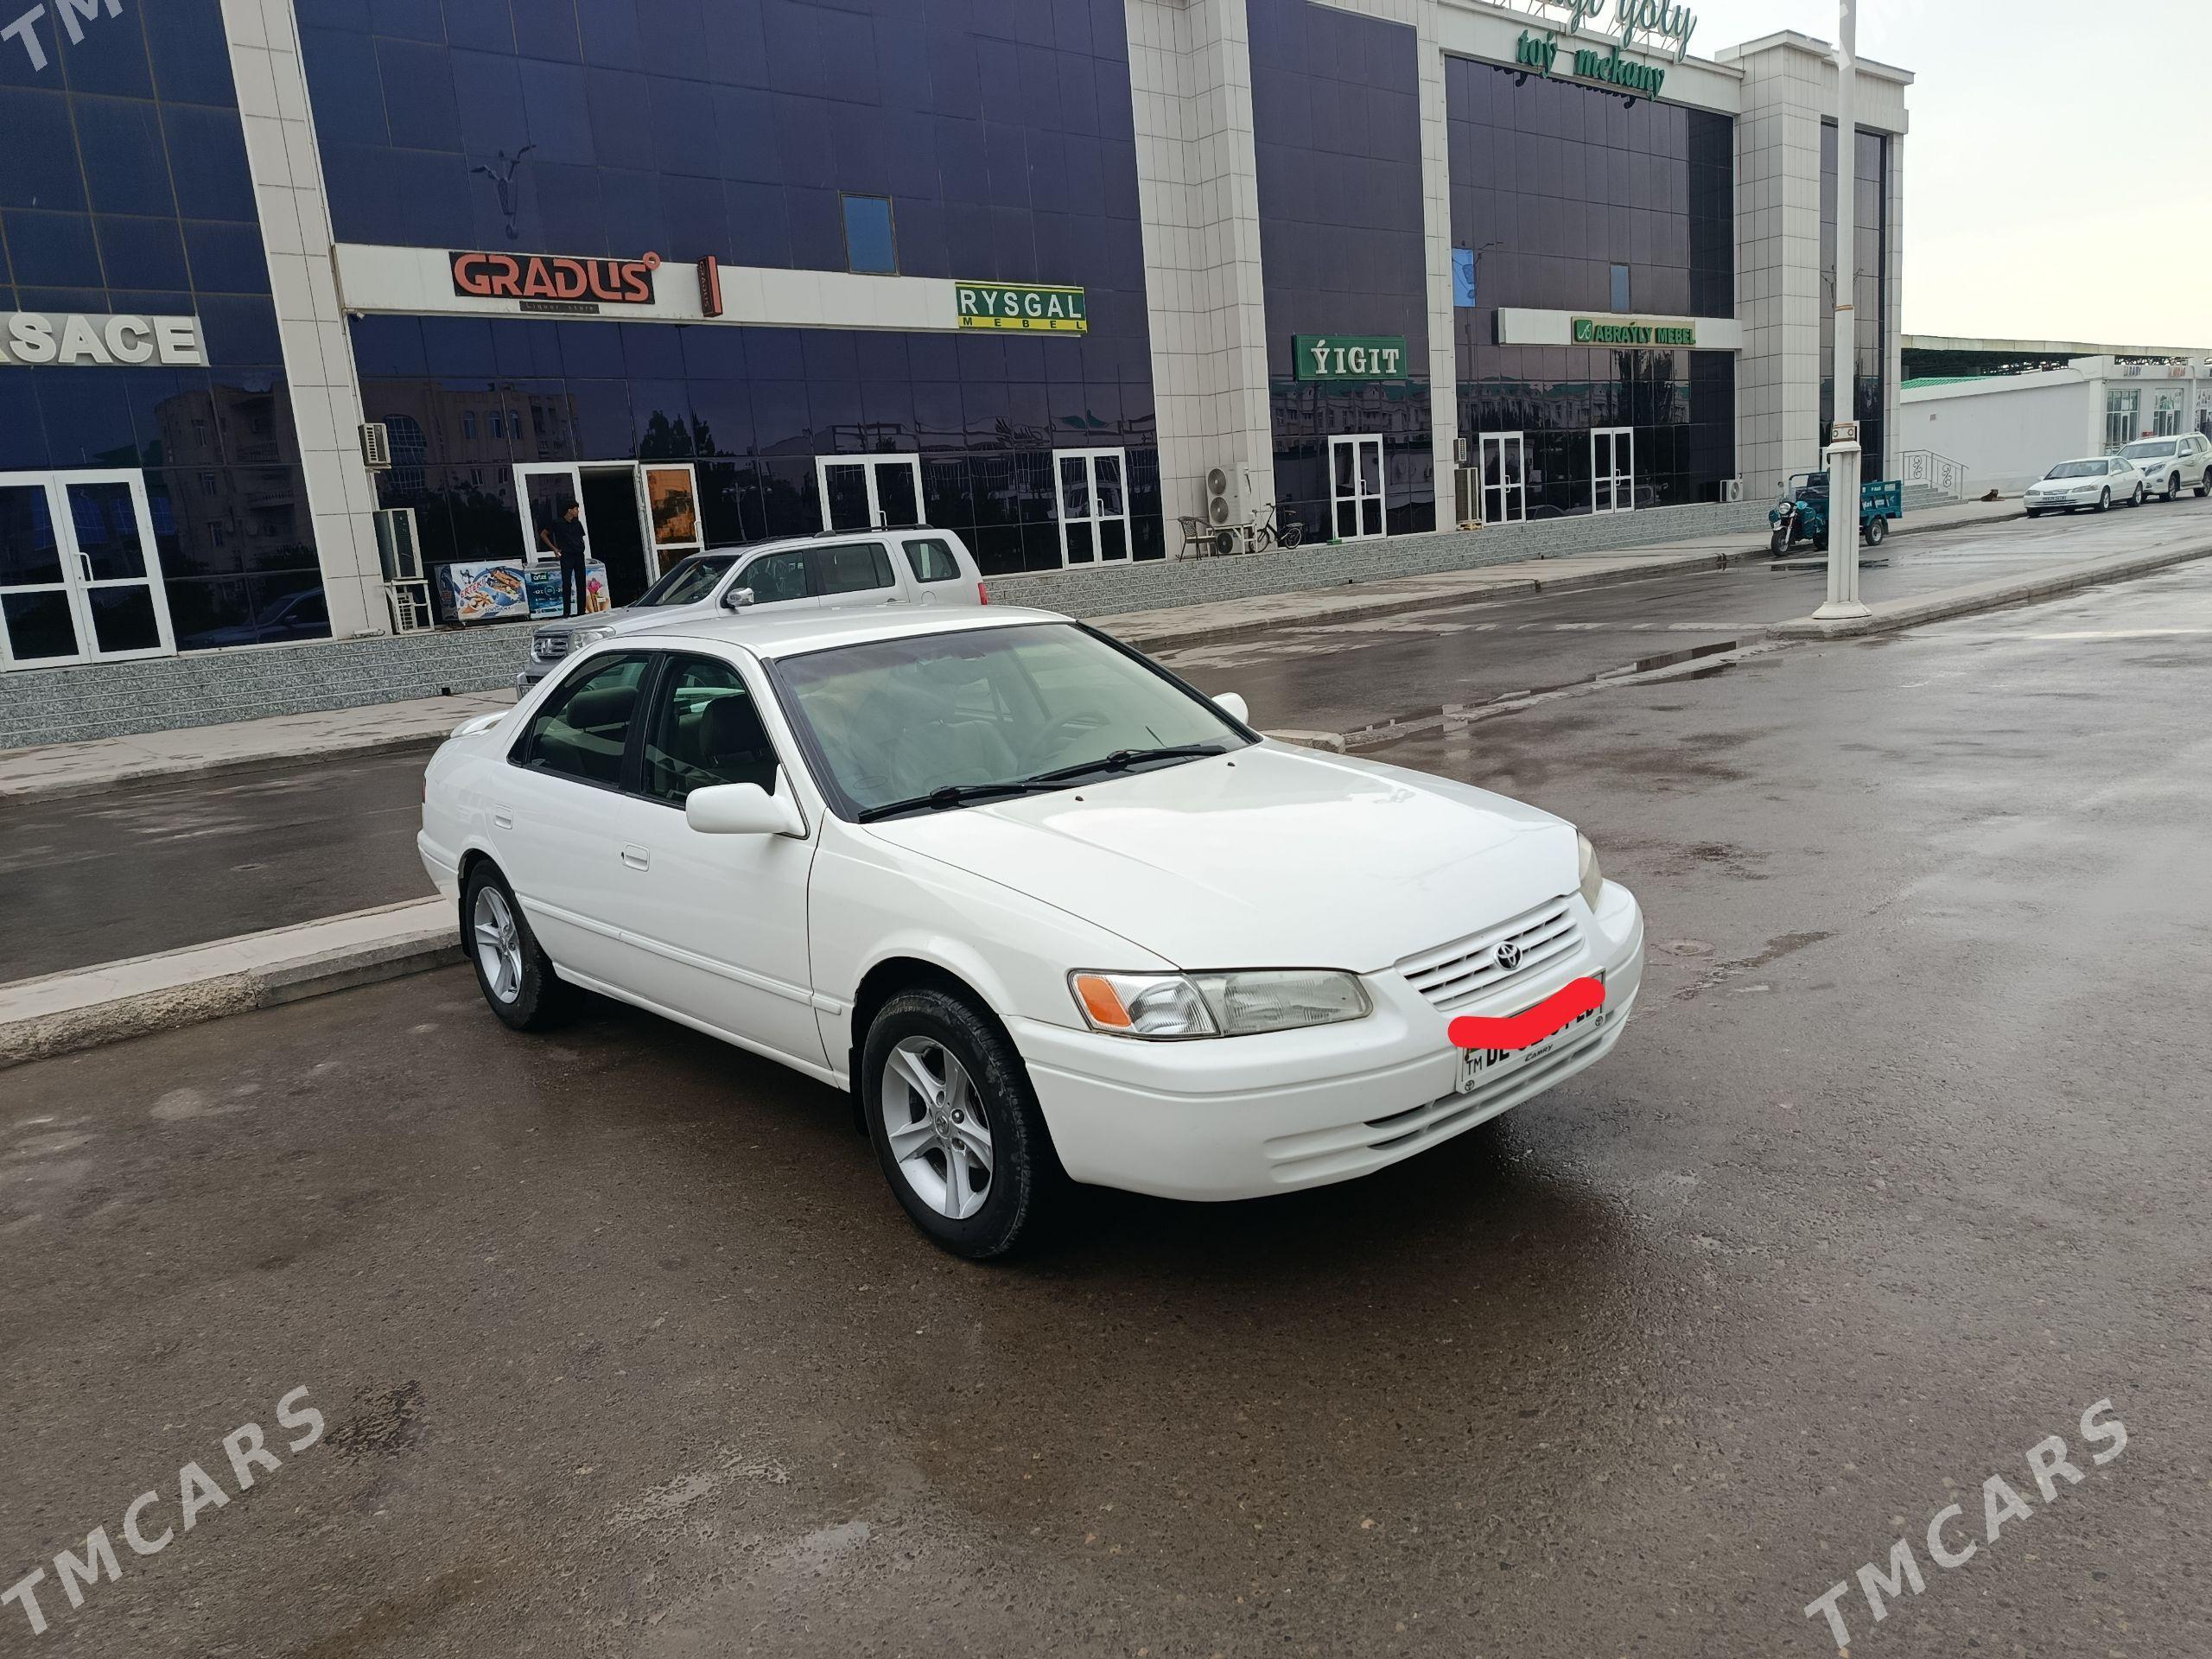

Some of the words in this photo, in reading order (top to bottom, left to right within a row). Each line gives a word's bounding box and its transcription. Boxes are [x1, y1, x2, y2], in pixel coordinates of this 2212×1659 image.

[1516, 29, 1558, 78] toý
[1574, 46, 1665, 101] mekany
[959, 289, 1082, 318] RYSGAL
[963, 318, 1083, 329] MEBEL
[1593, 321, 1653, 344] ABRAÝLY
[1655, 327, 1696, 345] MEBEL
[0, 312, 201, 364] SACE
[1310, 339, 1400, 375] ÝIGIT
[1467, 1055, 1483, 1076] TM
[1524, 1044, 1554, 1062] CAMRY
